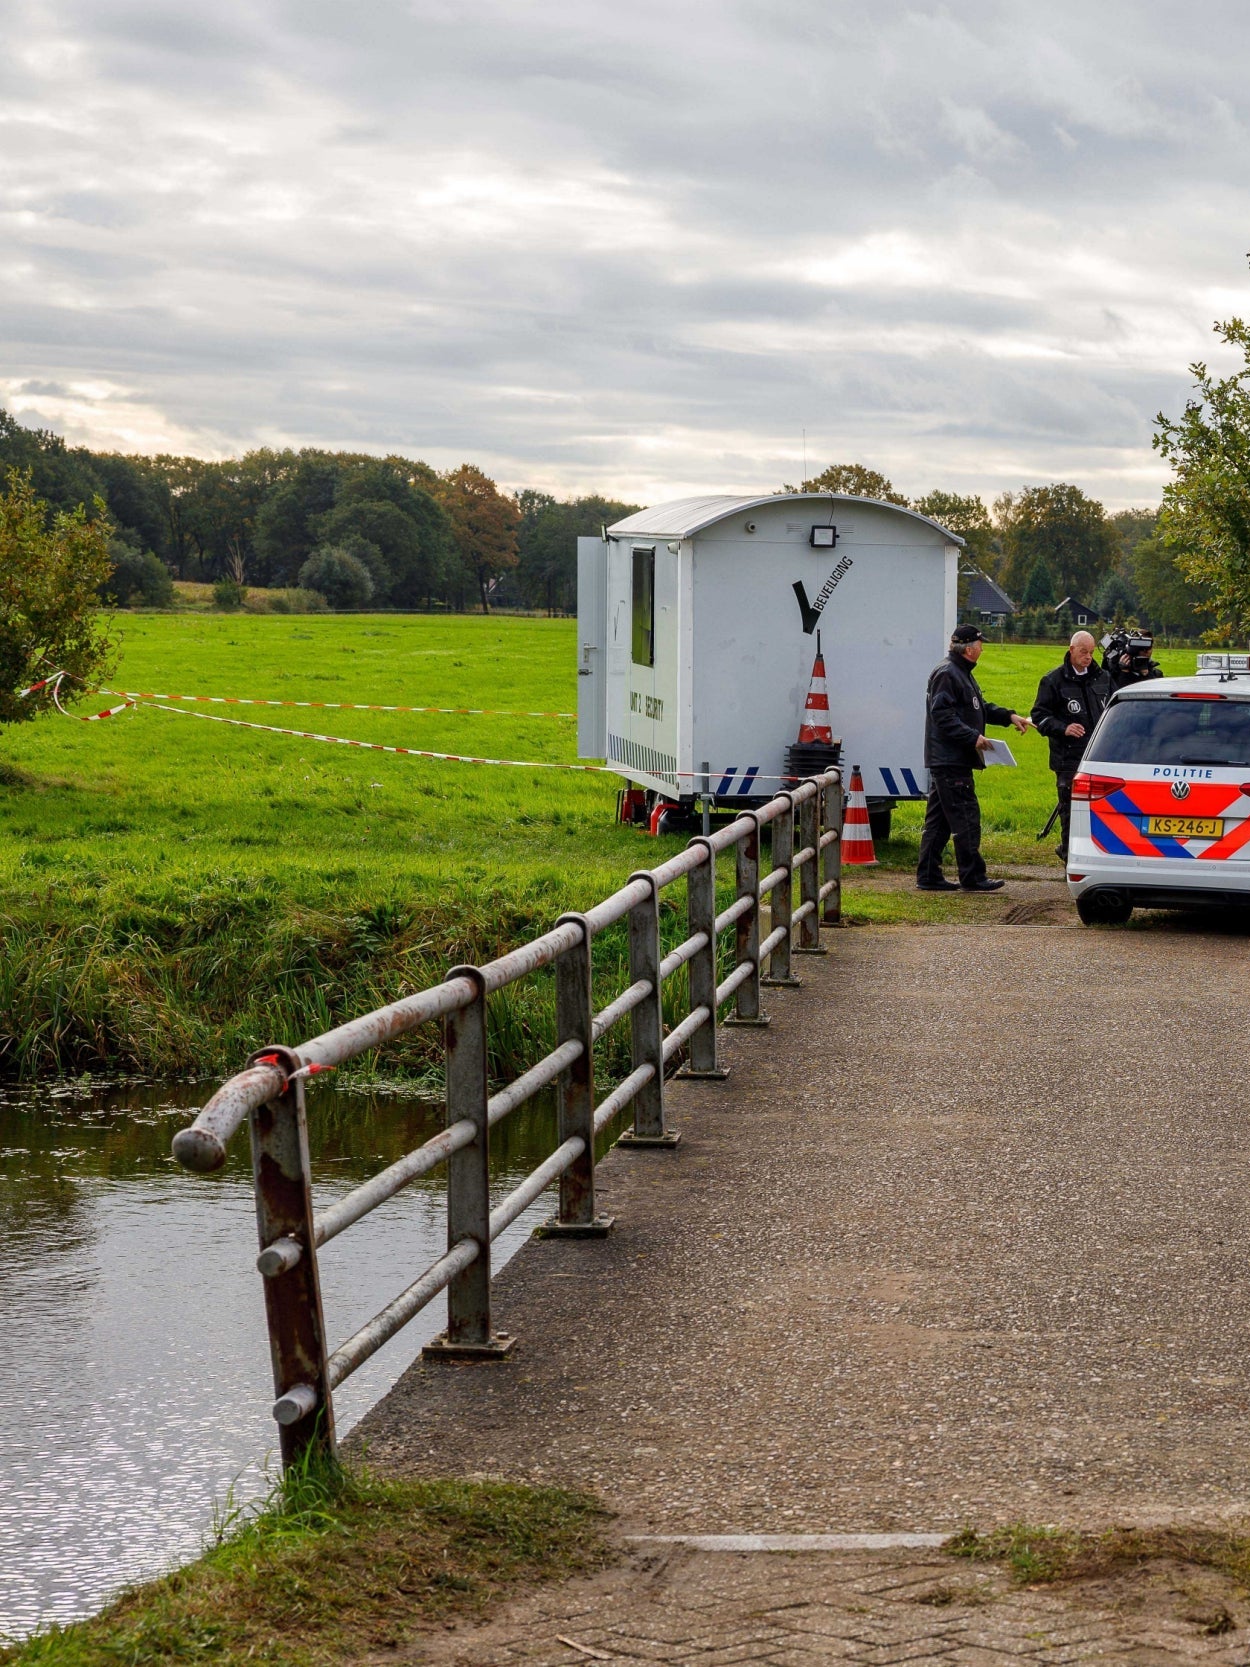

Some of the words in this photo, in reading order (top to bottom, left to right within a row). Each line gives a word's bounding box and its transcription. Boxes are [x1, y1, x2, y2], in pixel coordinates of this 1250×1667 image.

[813, 555, 854, 612] BEVEILIGING
[1153, 767, 1213, 779] POLITIE
[1153, 819, 1217, 834] KS-246-J
